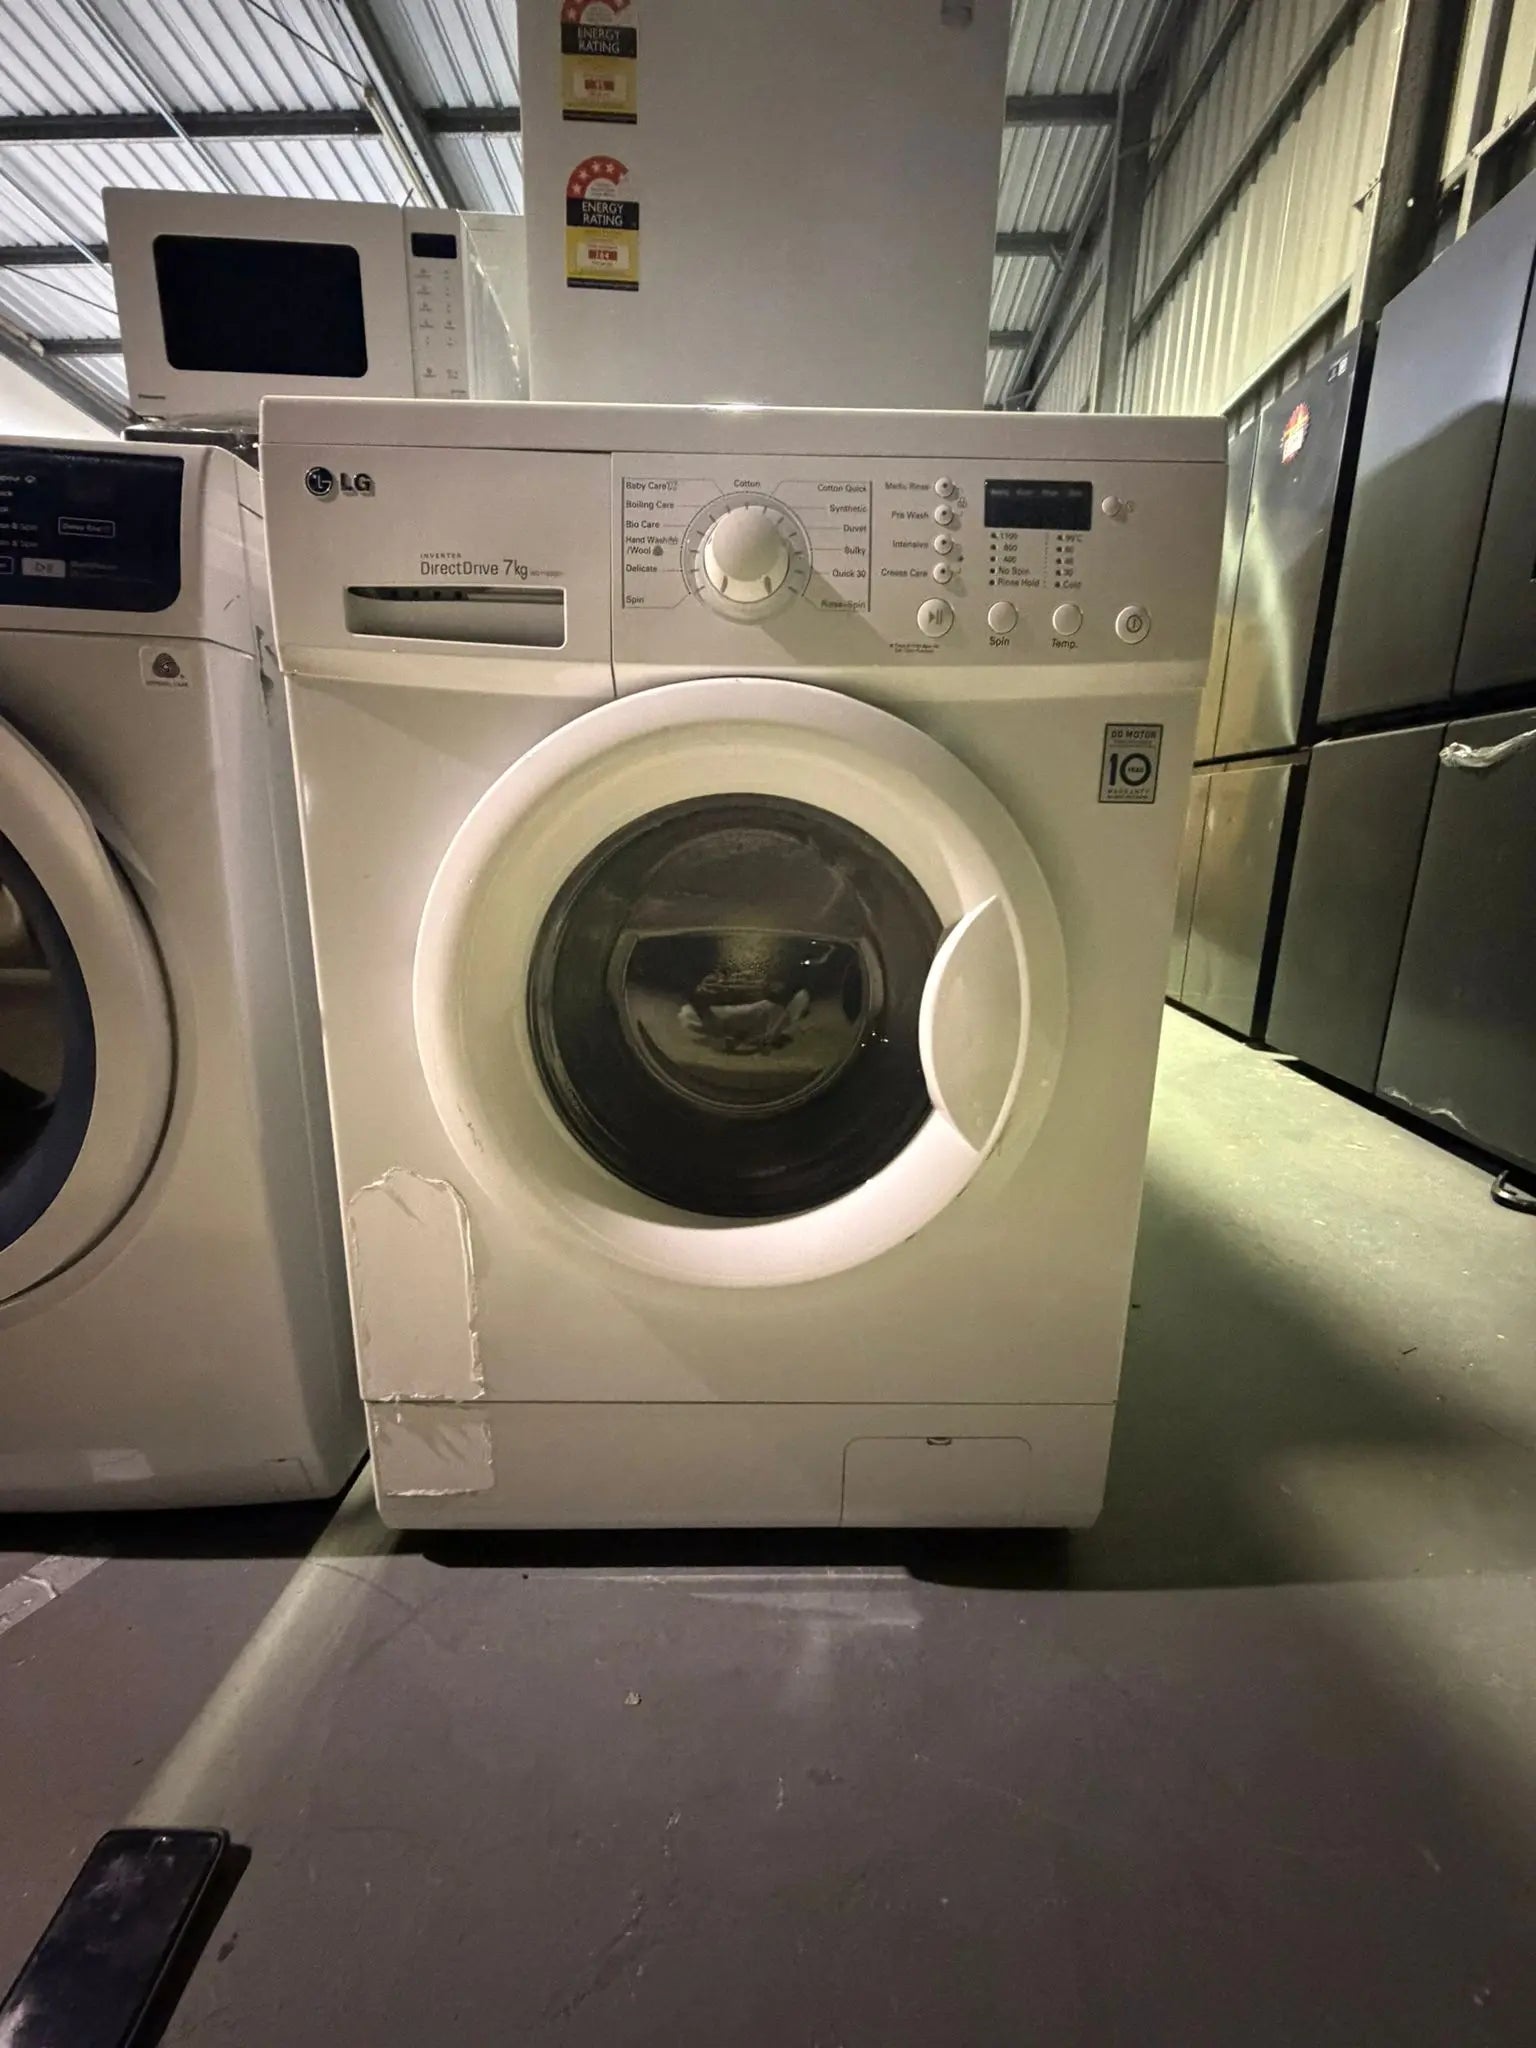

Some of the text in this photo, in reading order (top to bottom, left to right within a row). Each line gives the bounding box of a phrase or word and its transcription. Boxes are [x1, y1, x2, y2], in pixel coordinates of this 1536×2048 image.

[577, 27, 620, 40] ENERGY
[578, 40, 620, 54] RATING
[582, 201, 624, 214] ENERGY
[583, 213, 623, 226] RATING
[340, 473, 371, 492] LG
[626, 481, 667, 491] Baby Care
[733, 479, 761, 488] Cotton
[817, 483, 867, 493] Cotton Quick
[626, 500, 674, 511] Boiling Care
[829, 504, 867, 514] Synthetic
[907, 511, 929, 520] Wash
[626, 520, 660, 528] Bio Care
[626, 536, 645, 544] Hand
[892, 540, 929, 549] Intensive
[844, 546, 866, 556] Bulky
[626, 564, 658, 572] Delicate
[910, 568, 928, 577] Care
[832, 569, 854, 578] Quick
[626, 595, 645, 605] Spin
[989, 636, 1010, 648] Spin
[1051, 637, 1078, 650] Temp.
[1125, 730, 1157, 739] MOTOR
[1109, 753, 1152, 787] 10
